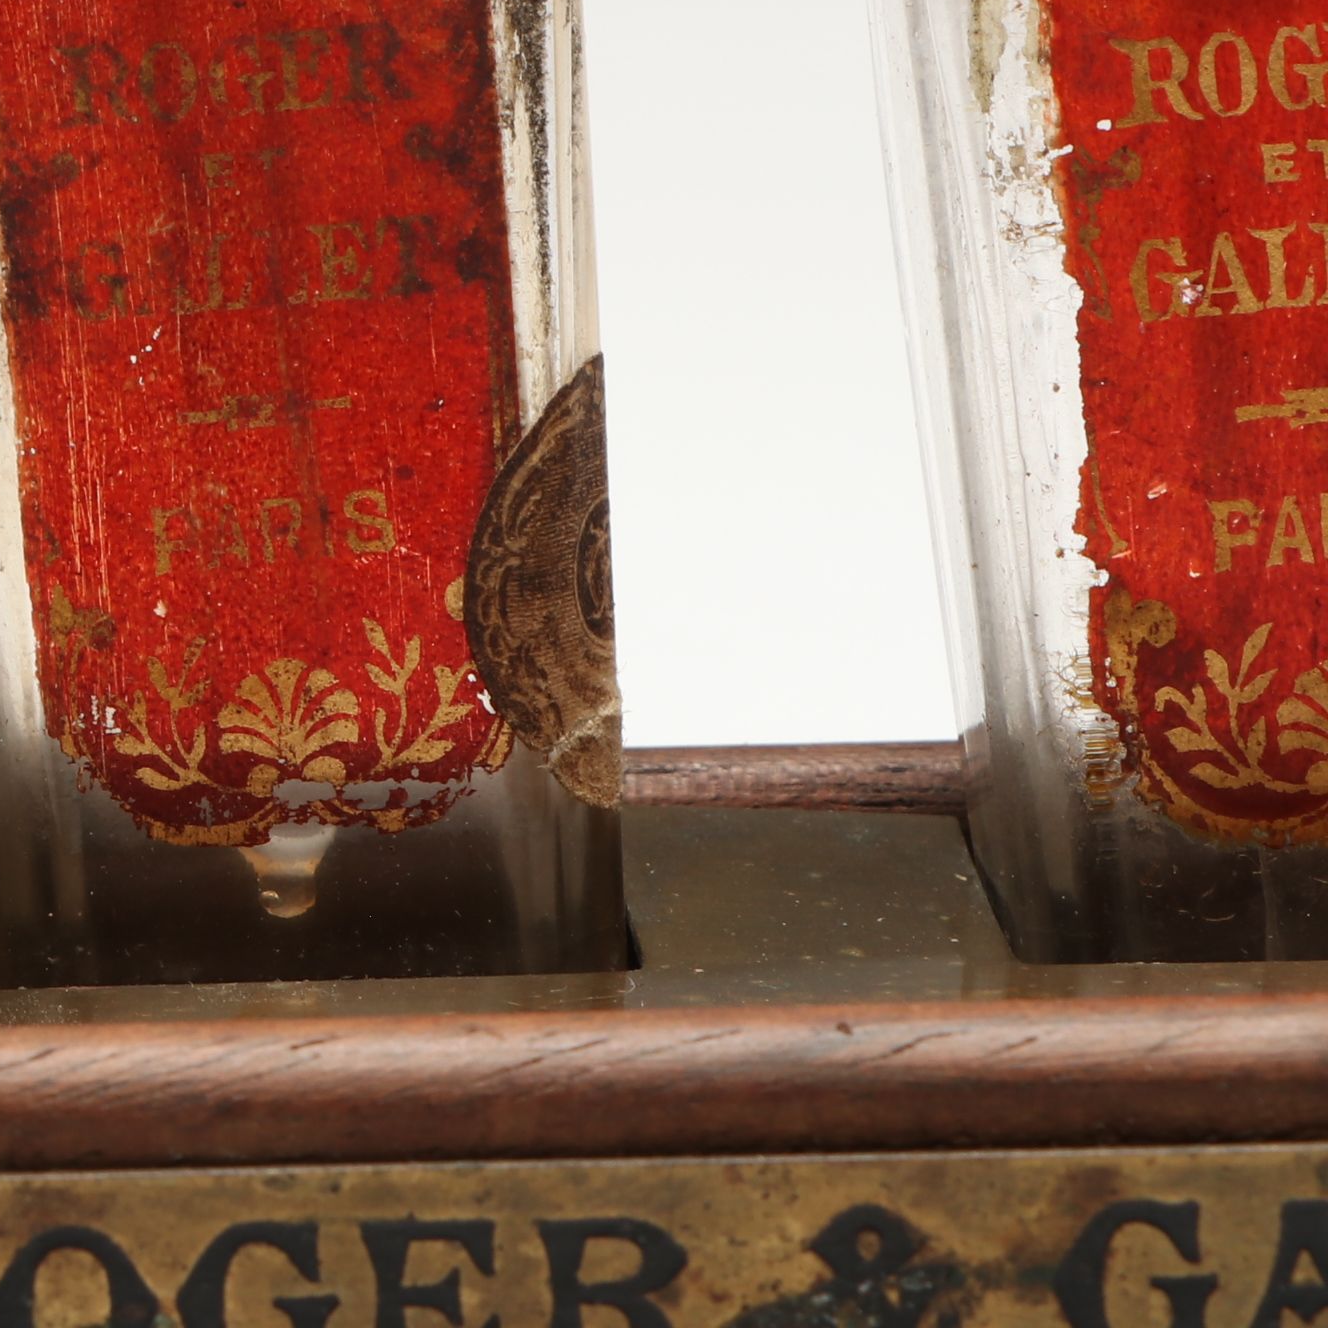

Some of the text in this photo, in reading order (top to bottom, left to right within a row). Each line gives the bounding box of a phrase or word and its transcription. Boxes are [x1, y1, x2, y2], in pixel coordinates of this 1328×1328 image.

[52, 20, 412, 130] ROGER
[201, 147, 288, 191] ET
[70, 213, 440, 324] GLET
[1210, 492, 1328, 573] PA
